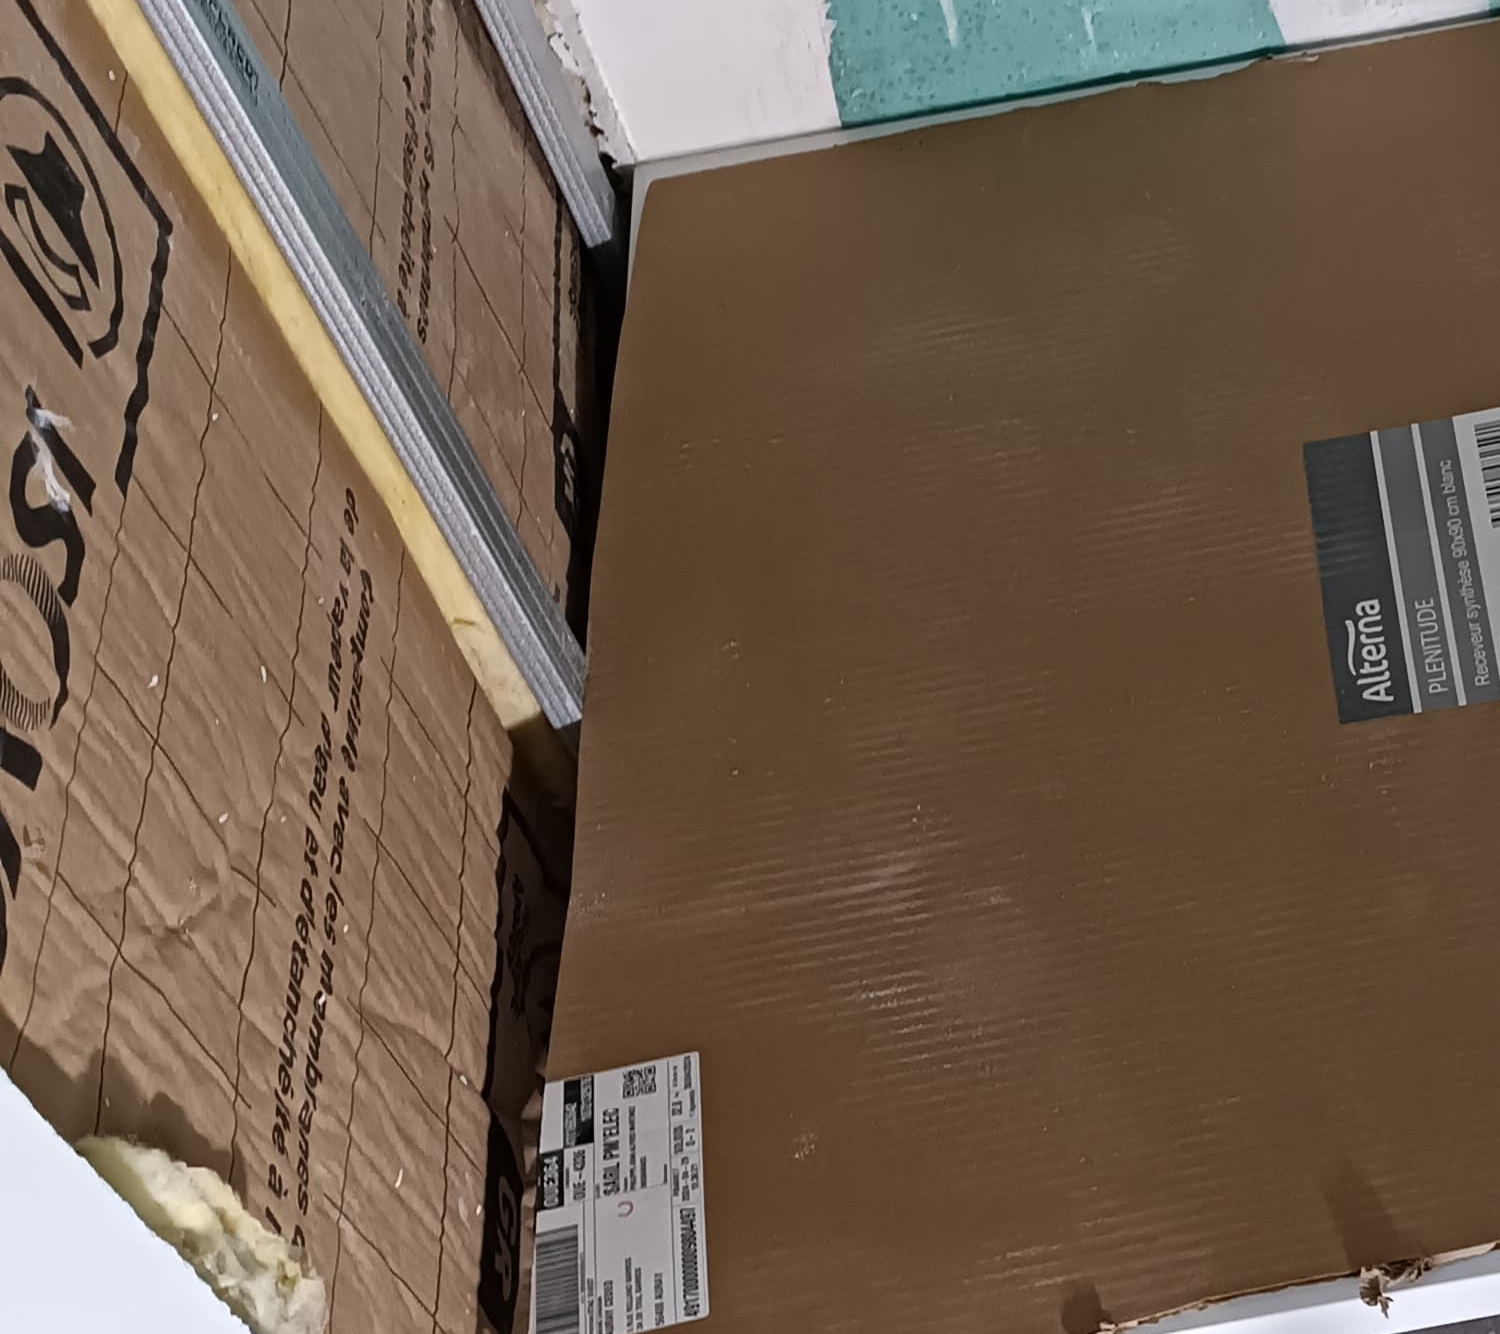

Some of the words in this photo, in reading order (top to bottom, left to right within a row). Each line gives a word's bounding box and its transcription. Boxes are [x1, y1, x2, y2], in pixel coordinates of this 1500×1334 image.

[344, 486, 358, 536] de
[1436, 458, 1456, 494] blanc
[1445, 496, 1460, 516] cm
[339, 536, 355, 577] la
[1446, 517, 1468, 558] 90x90
[1454, 558, 1482, 619] synthèse
[328, 580, 350, 712] vapeur
[341, 568, 374, 773] Compatible
[1346, 597, 1394, 707] Alterna
[1414, 597, 1449, 694] PLENITUDE
[1464, 620, 1491, 686] Receveur
[309, 712, 333, 821] d'eau
[303, 824, 319, 878] et
[330, 775, 350, 876] avec
[323, 877, 344, 947] les
[271, 878, 317, 1160] d'étanchéité
[297, 948, 334, 1217] membranes
[267, 1162, 288, 1200] à
[493, 1174, 519, 1302] GR
